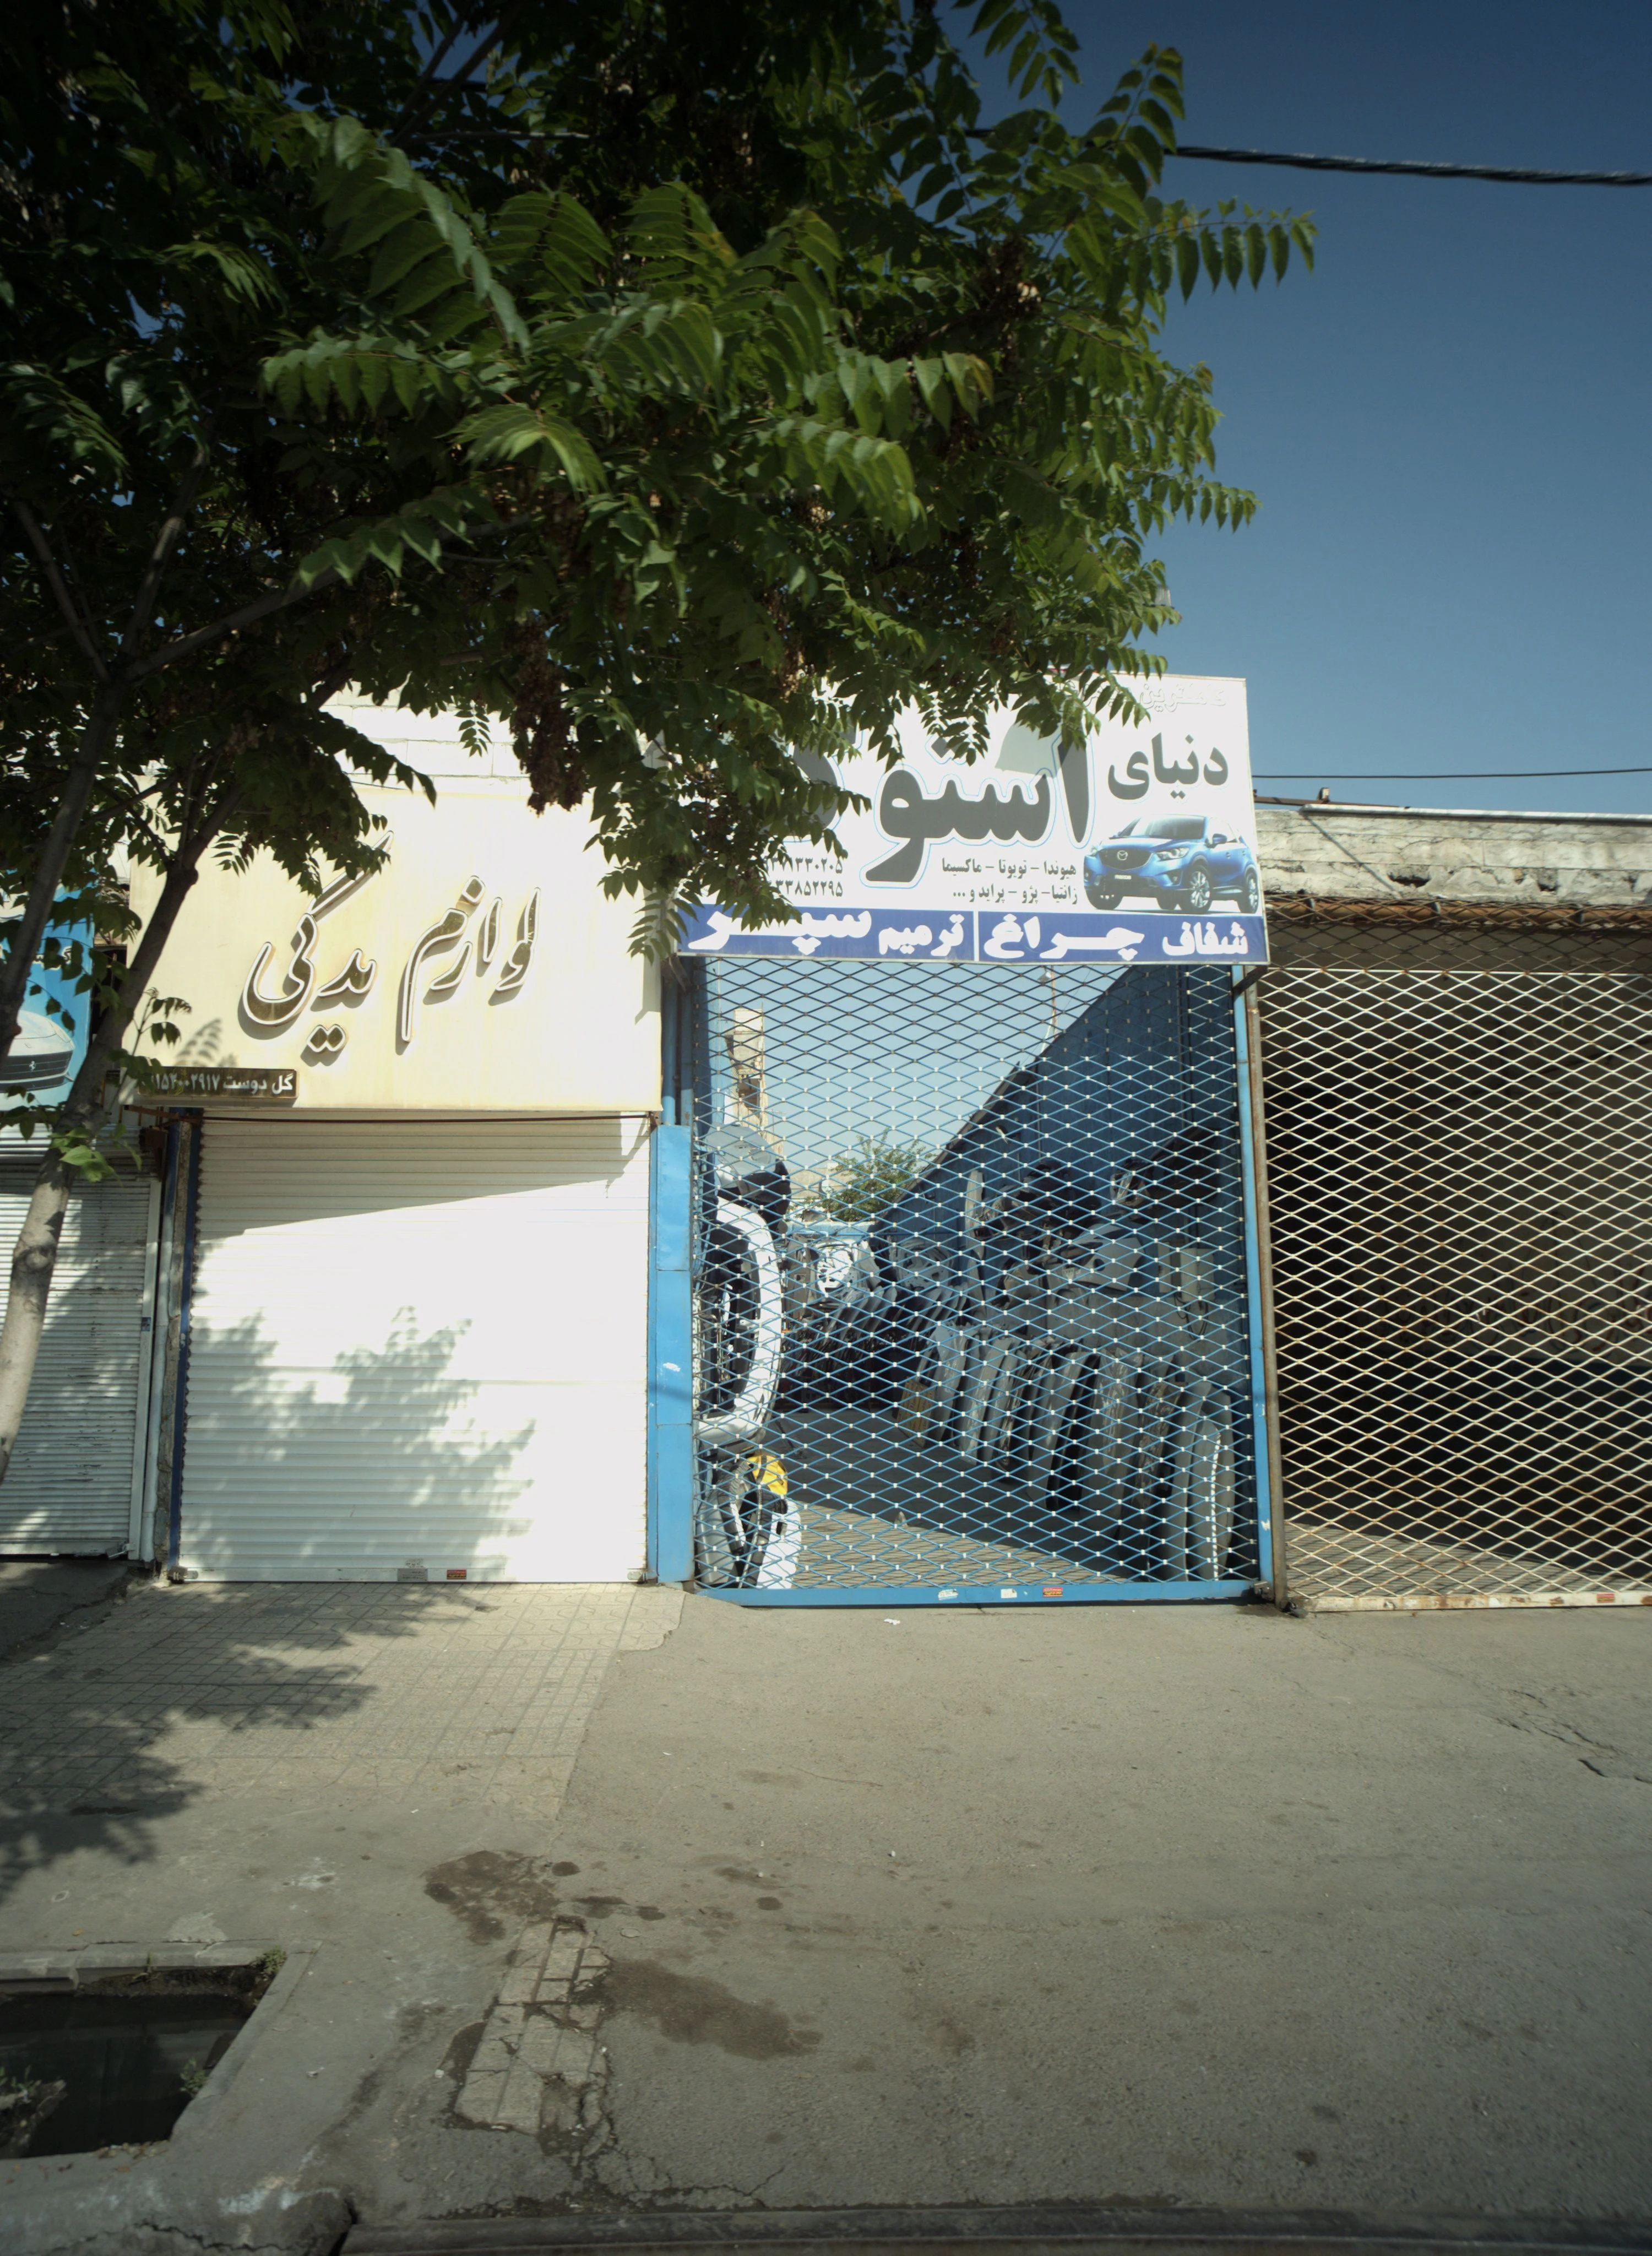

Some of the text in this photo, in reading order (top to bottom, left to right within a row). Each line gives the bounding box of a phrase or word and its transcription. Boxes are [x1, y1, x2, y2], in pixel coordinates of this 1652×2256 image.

[1108, 732, 1229, 800] دنیای
[942, 858, 982, 876] ماکسیما
[998, 859, 1027, 879] تویوتا
[1044, 860, 1077, 880] هیوندا
[767, 880, 843, 897] ۳۳۸۵۲۲۹۵
[978, 883, 1004, 903] پراید
[1022, 885, 1038, 904] پژو
[242, 830, 541, 1054] لوازم یدکی
[688, 910, 964, 956] ترمیم سپر
[983, 913, 1249, 961] شفاف چراغ
[223, 1075, 267, 1094] دوست
[271, 1072, 294, 1095] گل
